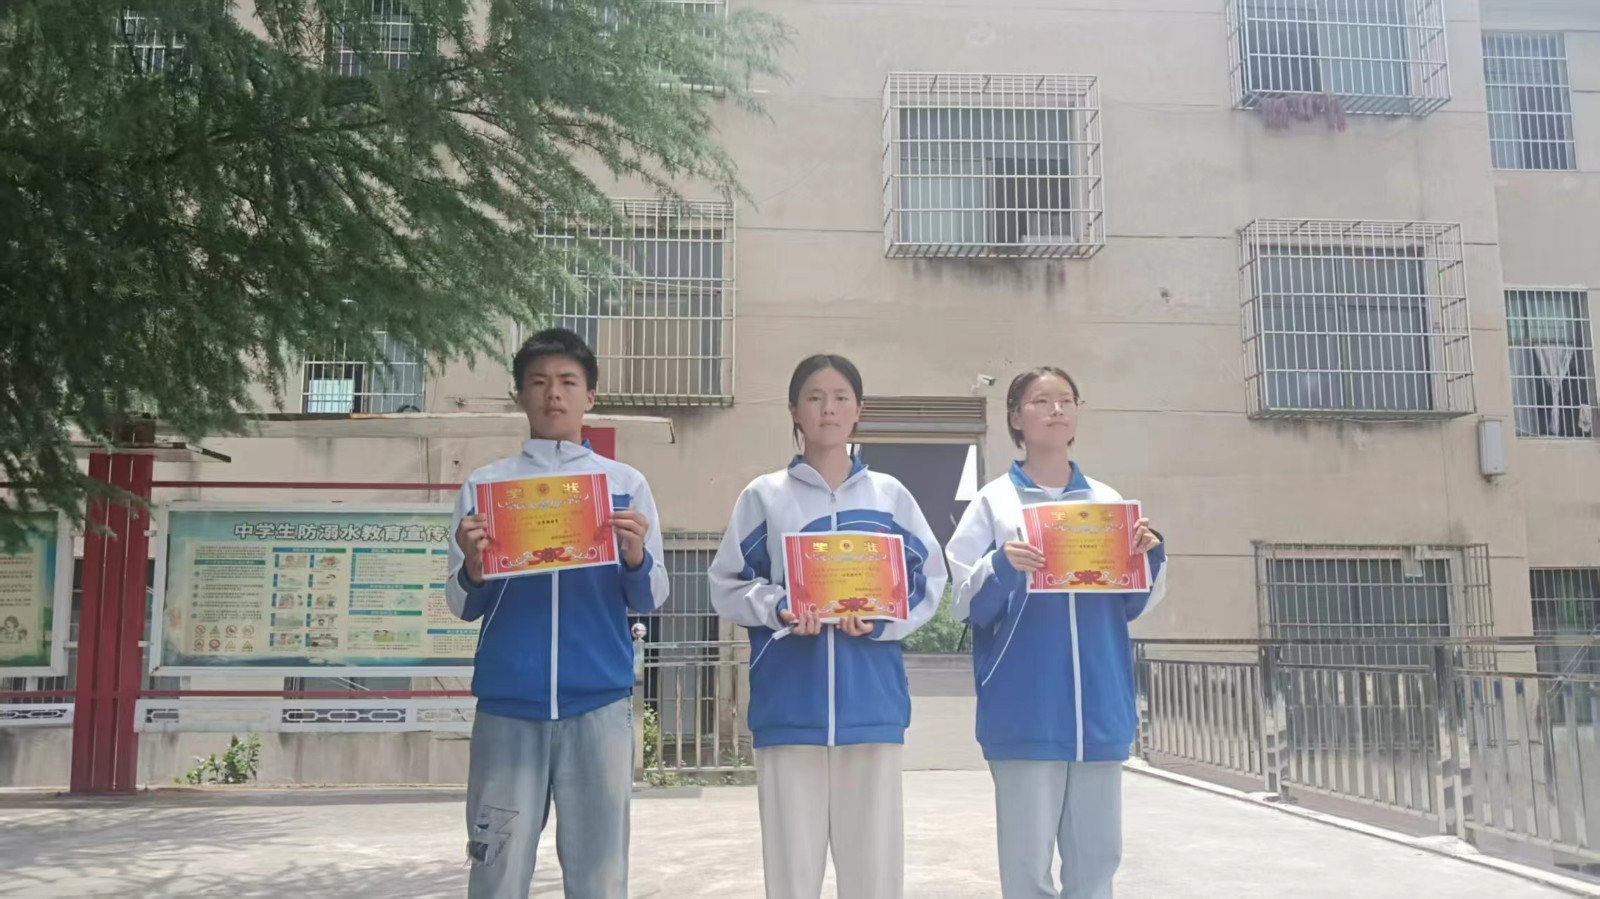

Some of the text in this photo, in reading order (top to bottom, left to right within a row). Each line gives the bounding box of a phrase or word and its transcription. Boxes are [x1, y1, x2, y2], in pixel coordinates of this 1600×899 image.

[234, 522, 450, 543] 中学生防溺水教育宣传
